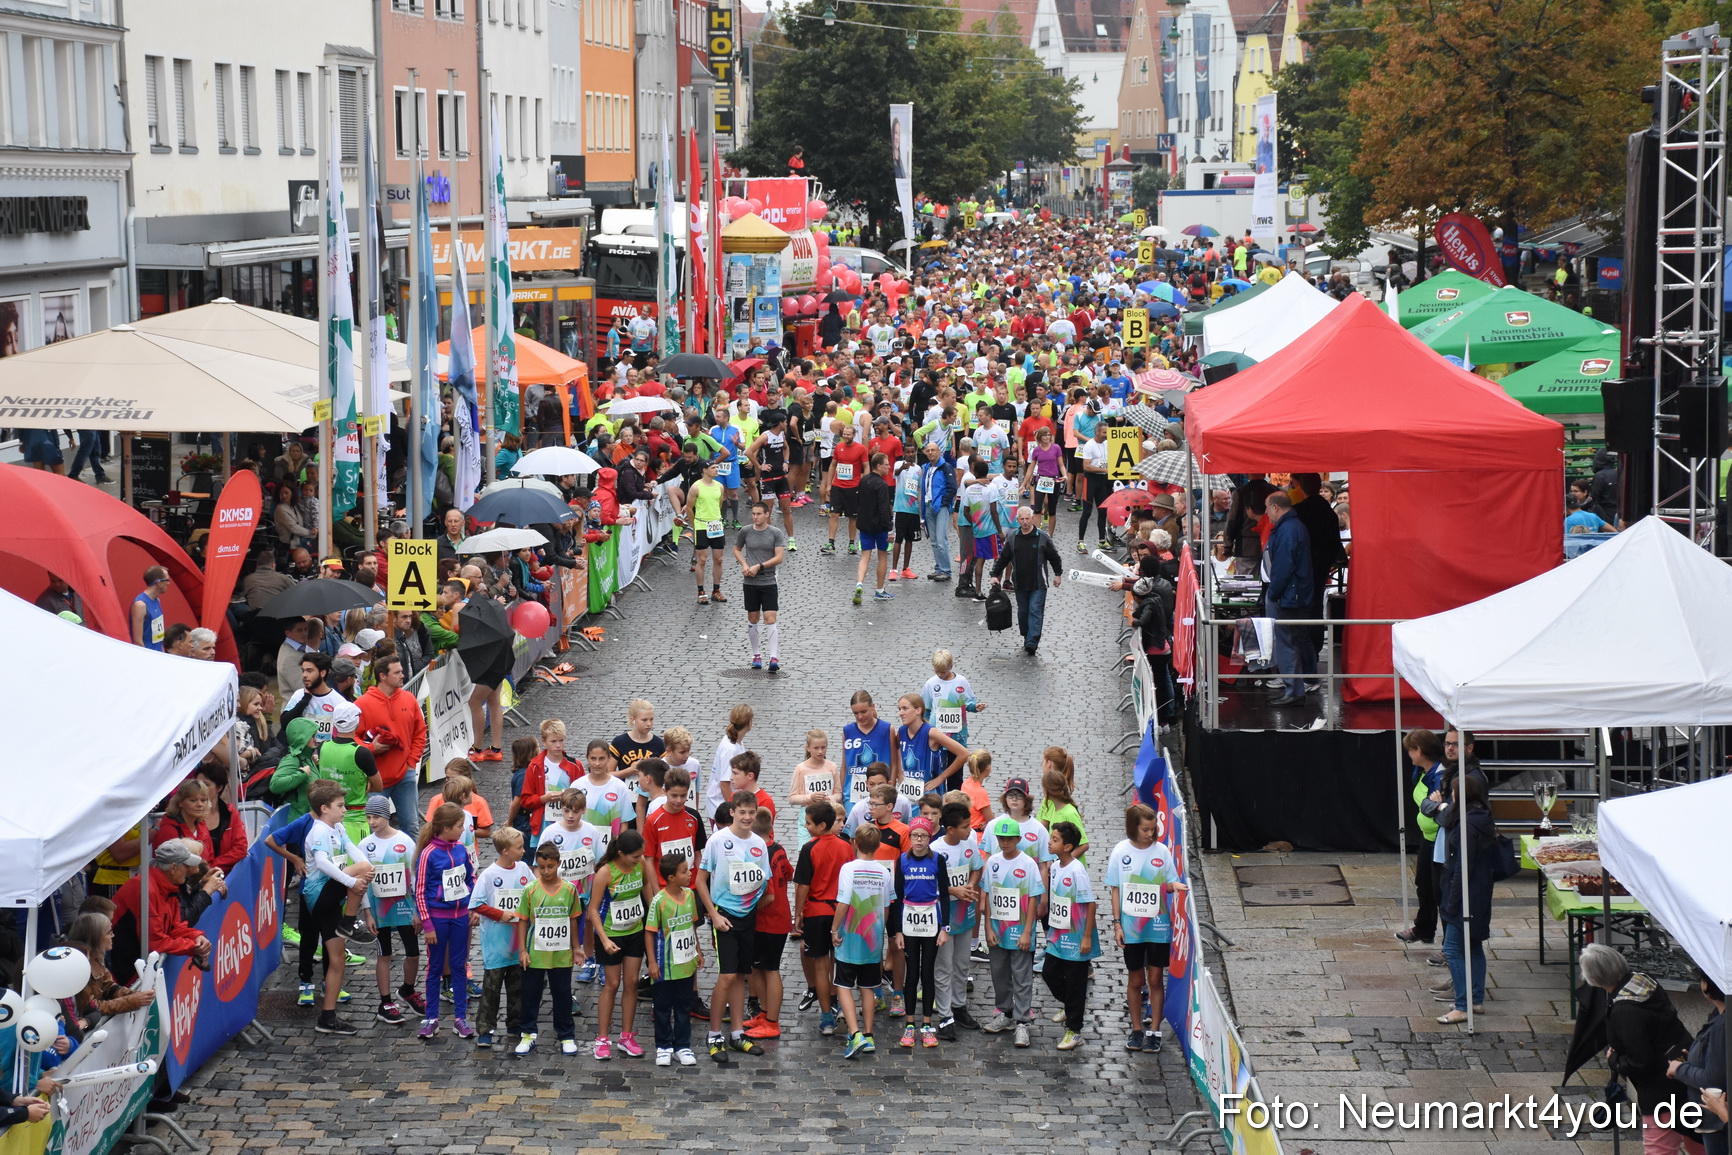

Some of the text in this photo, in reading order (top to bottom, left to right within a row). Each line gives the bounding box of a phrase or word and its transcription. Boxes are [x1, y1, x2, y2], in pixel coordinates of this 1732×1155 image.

[711, 11, 732, 130] HOTEL
[46, 196, 91, 230] WEBER
[1136, 214, 1143, 223] D
[966, 217, 974, 226] D
[792, 238, 812, 260] AVIA
[1142, 248, 1150, 260] C
[1443, 225, 1479, 270] Hervis
[611, 304, 638, 317] AVIA
[1126, 310, 1147, 318] Block
[1130, 320, 1143, 338] B
[1491, 327, 1552, 335] Neumarkter
[1481, 331, 1565, 342] Lammsbräu
[1537, 384, 1602, 393] Lamms
[1111, 430, 1138, 439] Block
[1115, 443, 1135, 468] A
[219, 508, 245, 522] DKMS
[394, 543, 432, 555] Block
[398, 561, 427, 595] A
[939, 713, 960, 723] 4003
[844, 738, 862, 750] 66
[622, 749, 653, 765] OSAK
[850, 766, 868, 774] FIBA
[809, 781, 832, 792] 4031
[562, 855, 587, 870] 4029
[374, 872, 402, 885] 4017
[734, 869, 763, 883] 4108
[614, 881, 642, 893] BOCK
[993, 895, 1017, 909] 4035
[1127, 891, 1157, 905] 4039
[257, 880, 277, 932] Hervi
[535, 906, 569, 916] BOCK
[615, 905, 642, 922] 4040
[906, 912, 934, 925] 4041
[538, 926, 568, 939] 4049
[216, 919, 252, 984] Hervis
[173, 976, 200, 1048] Hervis
